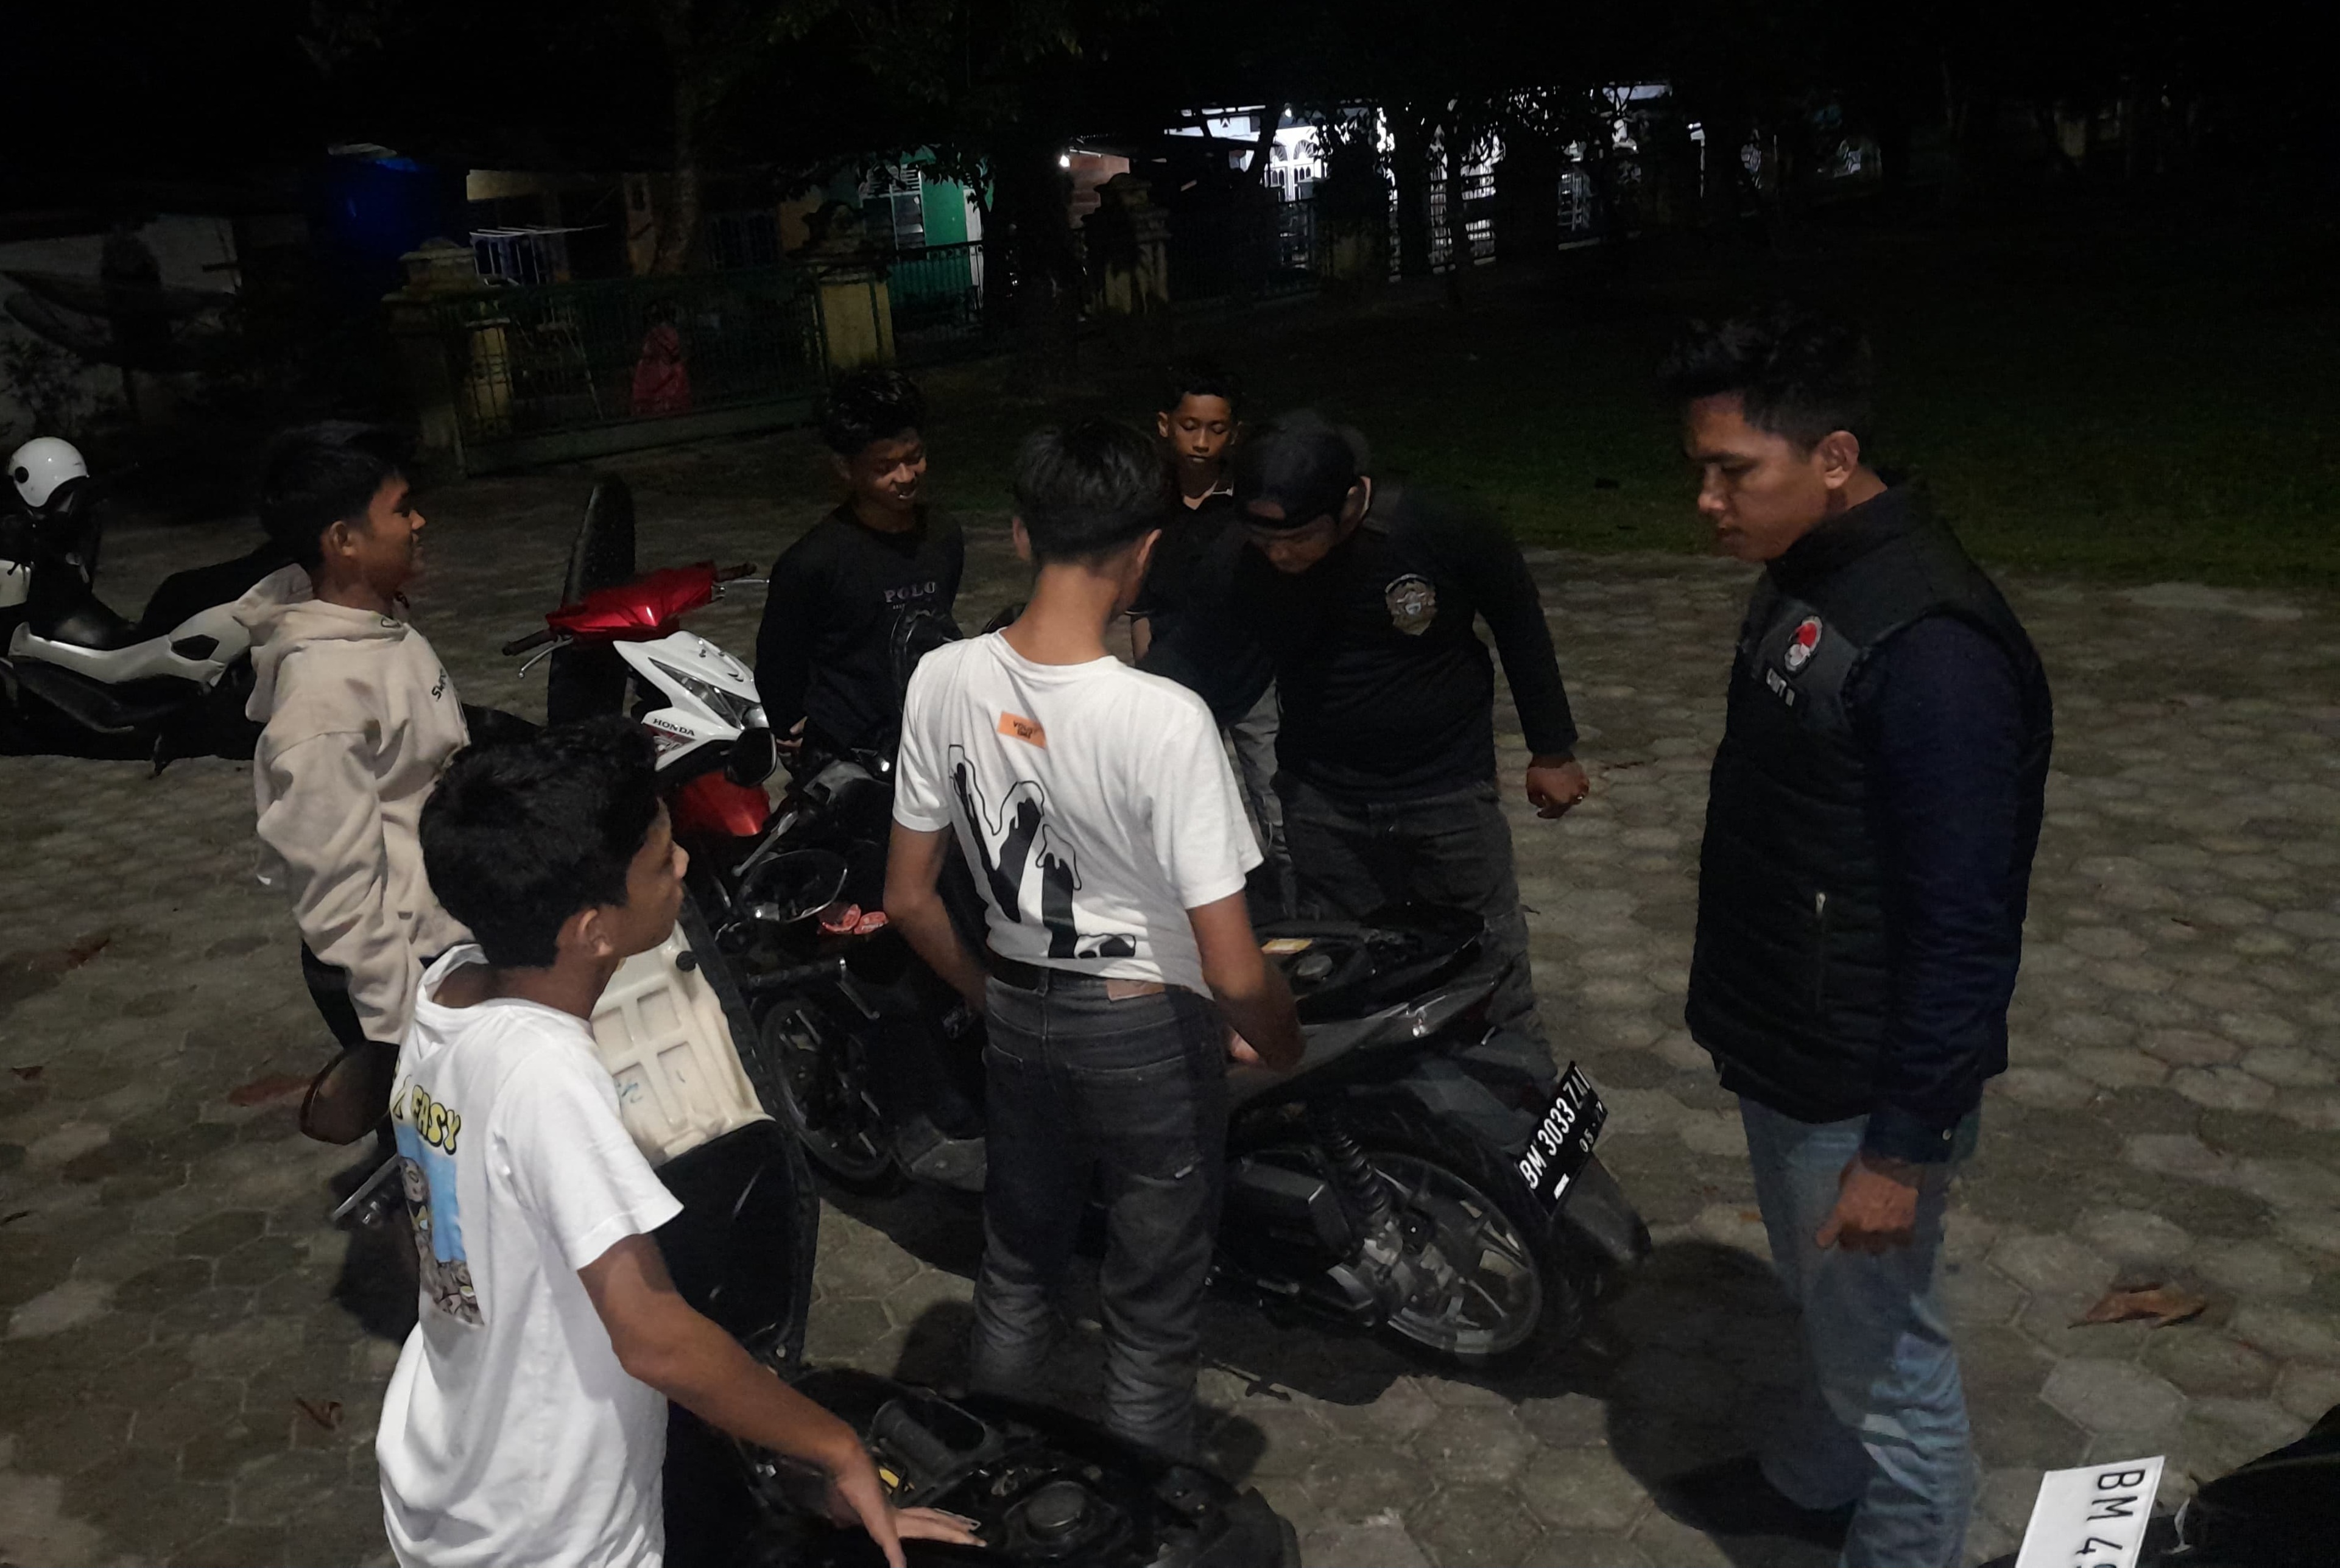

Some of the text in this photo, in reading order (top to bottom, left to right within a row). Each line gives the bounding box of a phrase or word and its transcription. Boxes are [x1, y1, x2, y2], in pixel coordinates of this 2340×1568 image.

[884, 581, 936, 603] POLO
[653, 719, 695, 736] HONDA
[411, 1085, 461, 1155] EASY
[1519, 1144, 1547, 1189] BM
[1537, 1097, 1576, 1156] 3033
[2075, 1469, 2146, 1568] BM 4
